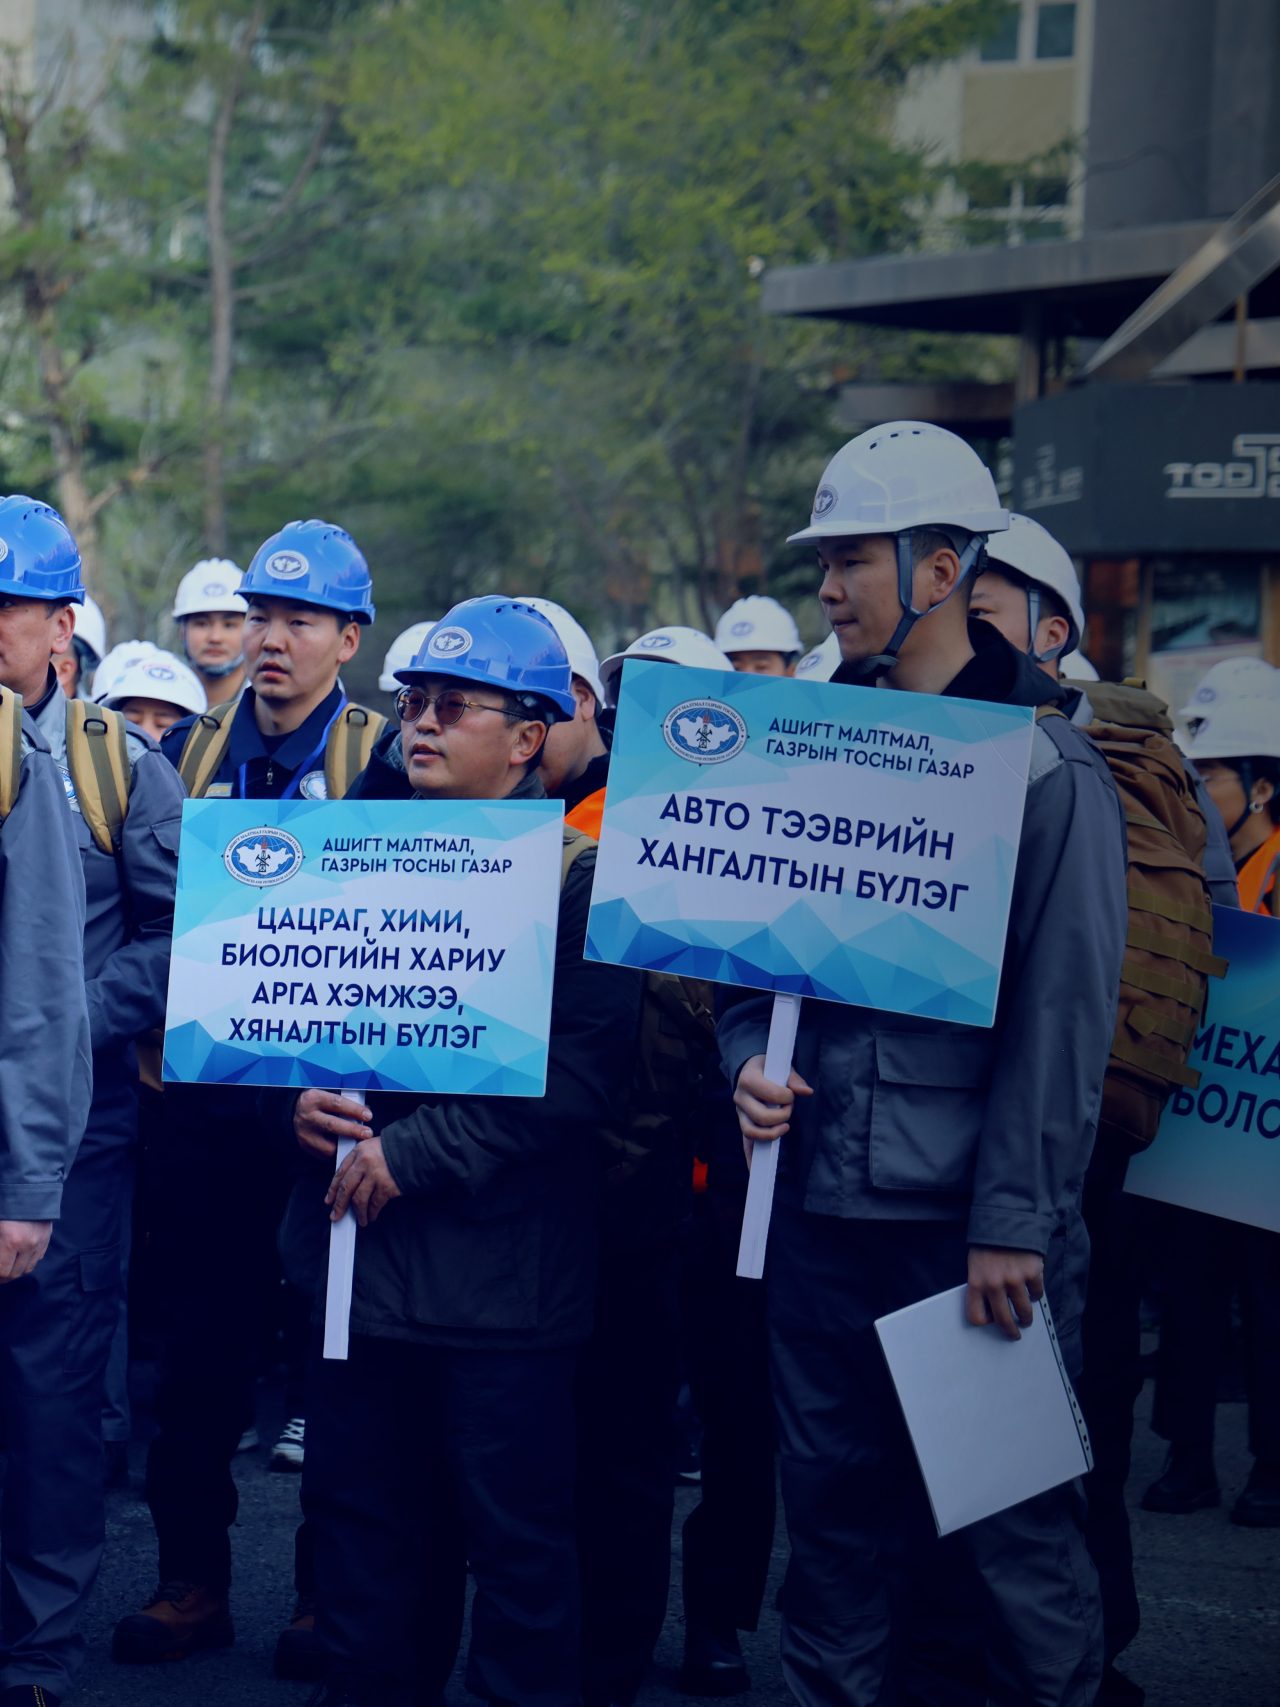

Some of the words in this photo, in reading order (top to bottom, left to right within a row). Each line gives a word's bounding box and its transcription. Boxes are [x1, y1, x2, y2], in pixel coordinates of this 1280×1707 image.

[768, 717, 834, 739] АШИГТ
[838, 726, 934, 755] МАЛТМАЛ,
[766, 739, 837, 761] ГАЗРЫН
[843, 748, 912, 771] ТОСНЫ
[918, 758, 974, 779] ГАЗАР
[660, 794, 750, 830] АВТО
[761, 806, 954, 860] ТЭЭВРИЙН
[322, 838, 382, 852] АШИГТ
[387, 838, 474, 855] МАЛТМАЛ,
[321, 859, 387, 872] ГАЗРЫН
[393, 859, 455, 873] ТОСНЫ
[461, 859, 512, 874] ГАЗАР
[637, 838, 844, 894] ХАНГАЛТЫН
[856, 870, 969, 912] БҮЛЭГ
[257, 907, 370, 937] ЦАЦРАГ,
[379, 909, 470, 938] ХИМИ,
[221, 939, 399, 970] БИОЛОГИЙН
[409, 948, 505, 972] ХАРИУ
[251, 982, 318, 1005] АРГА
[326, 984, 464, 1014] ХЭМЖЭЭ,
[228, 1018, 385, 1045] ХЯНАЛТЫН
[397, 1025, 487, 1048] БҮЛЭГ
